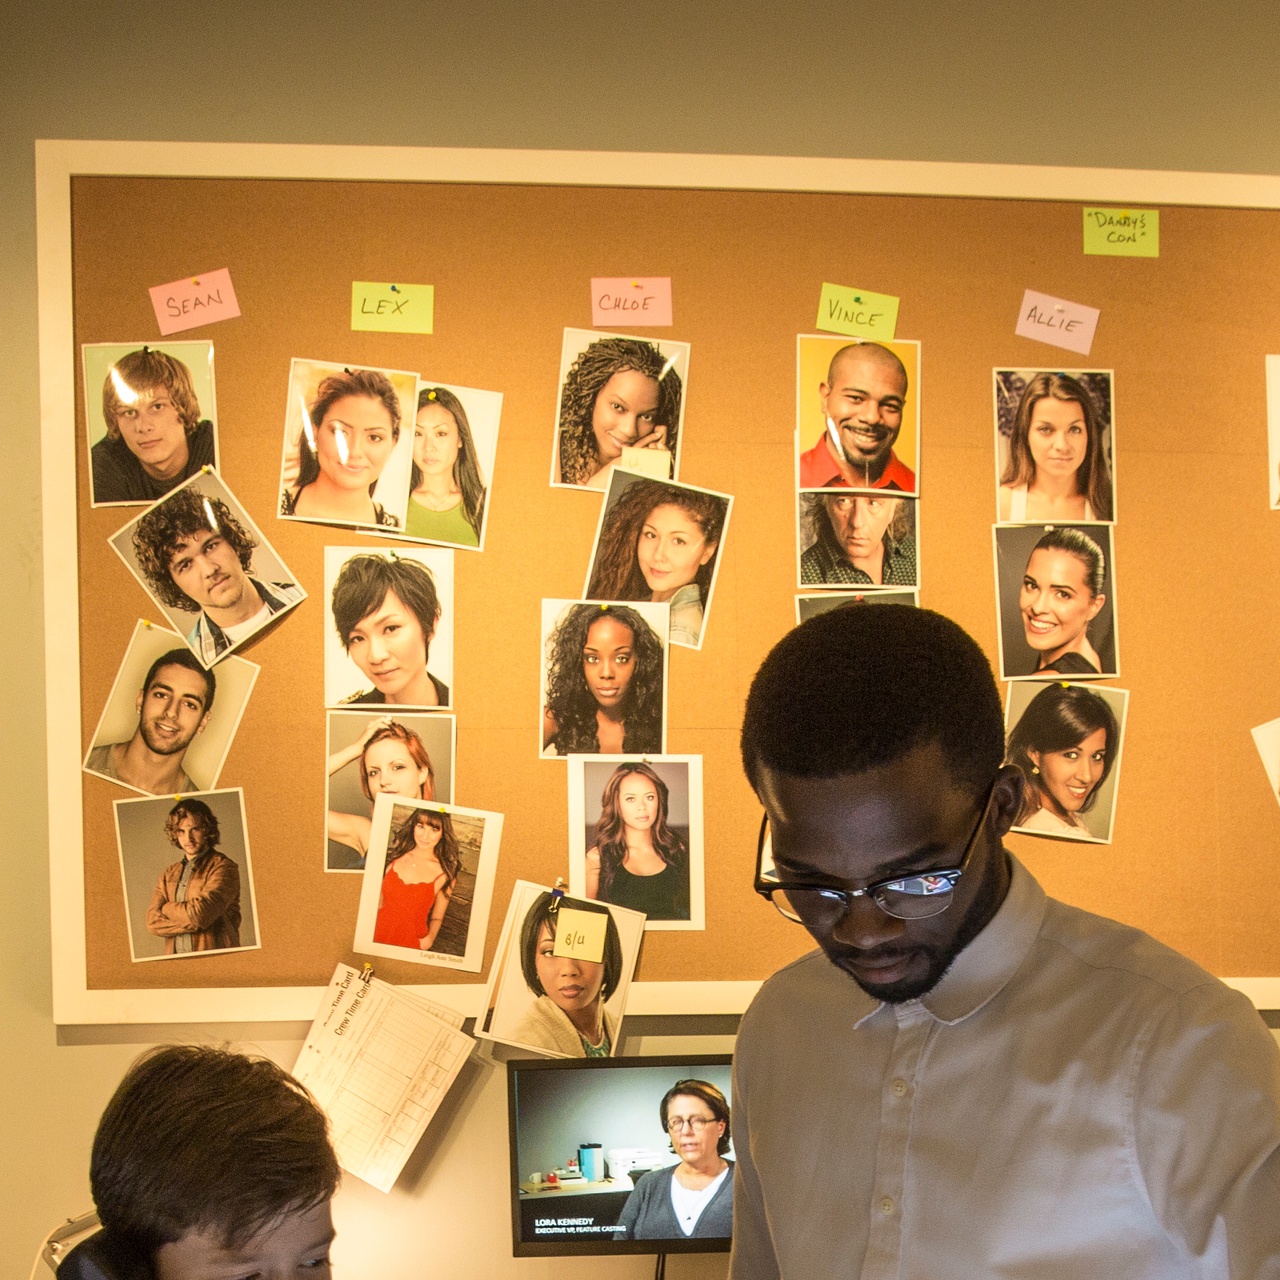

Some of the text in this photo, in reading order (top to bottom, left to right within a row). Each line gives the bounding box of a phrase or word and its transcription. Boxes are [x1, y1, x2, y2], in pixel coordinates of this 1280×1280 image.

[165, 289, 223, 318] SEAN
[360, 298, 410, 316] LEX
[597, 294, 657, 312] CHLOE
[828, 298, 884, 327] VINCE
[1025, 304, 1085, 333] ALLIE
[334, 1018, 351, 1037] Crew
[345, 998, 361, 1020] Time
[535, 1218, 594, 1227] LORA KENNEDY
